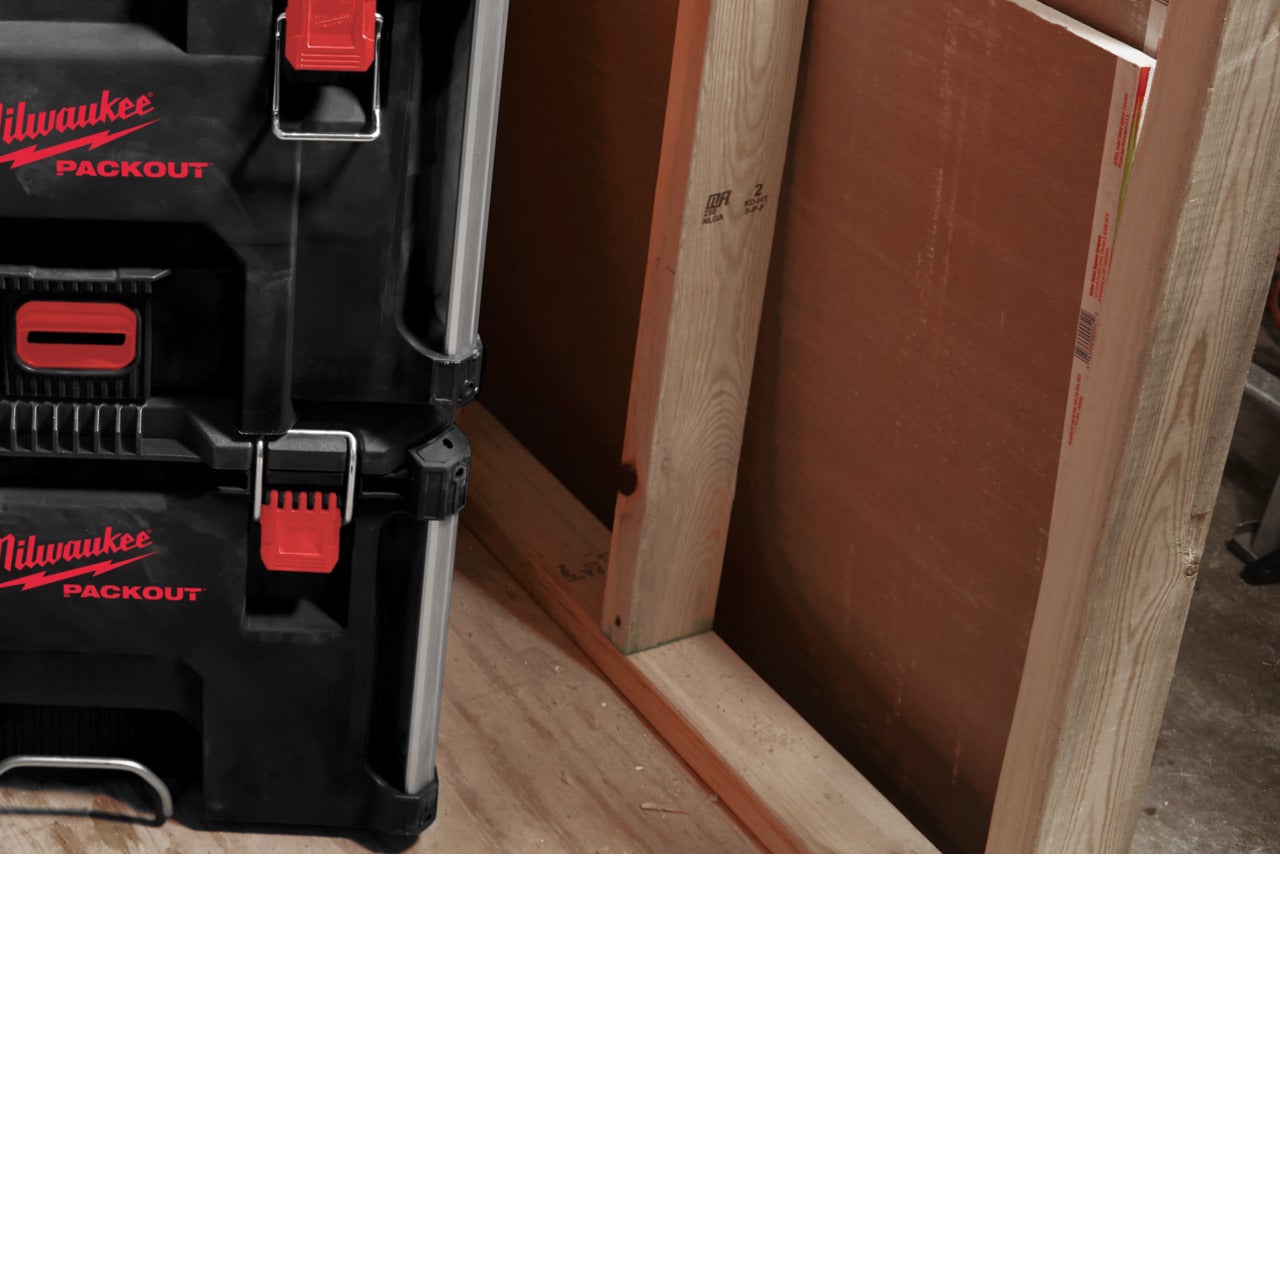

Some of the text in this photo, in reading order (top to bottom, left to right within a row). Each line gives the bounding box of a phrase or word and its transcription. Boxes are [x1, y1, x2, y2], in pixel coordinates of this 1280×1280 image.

[56, 160, 209, 178] PACKOUT
[753, 183, 763, 197] 2
[63, 584, 203, 601] PACKOUT
